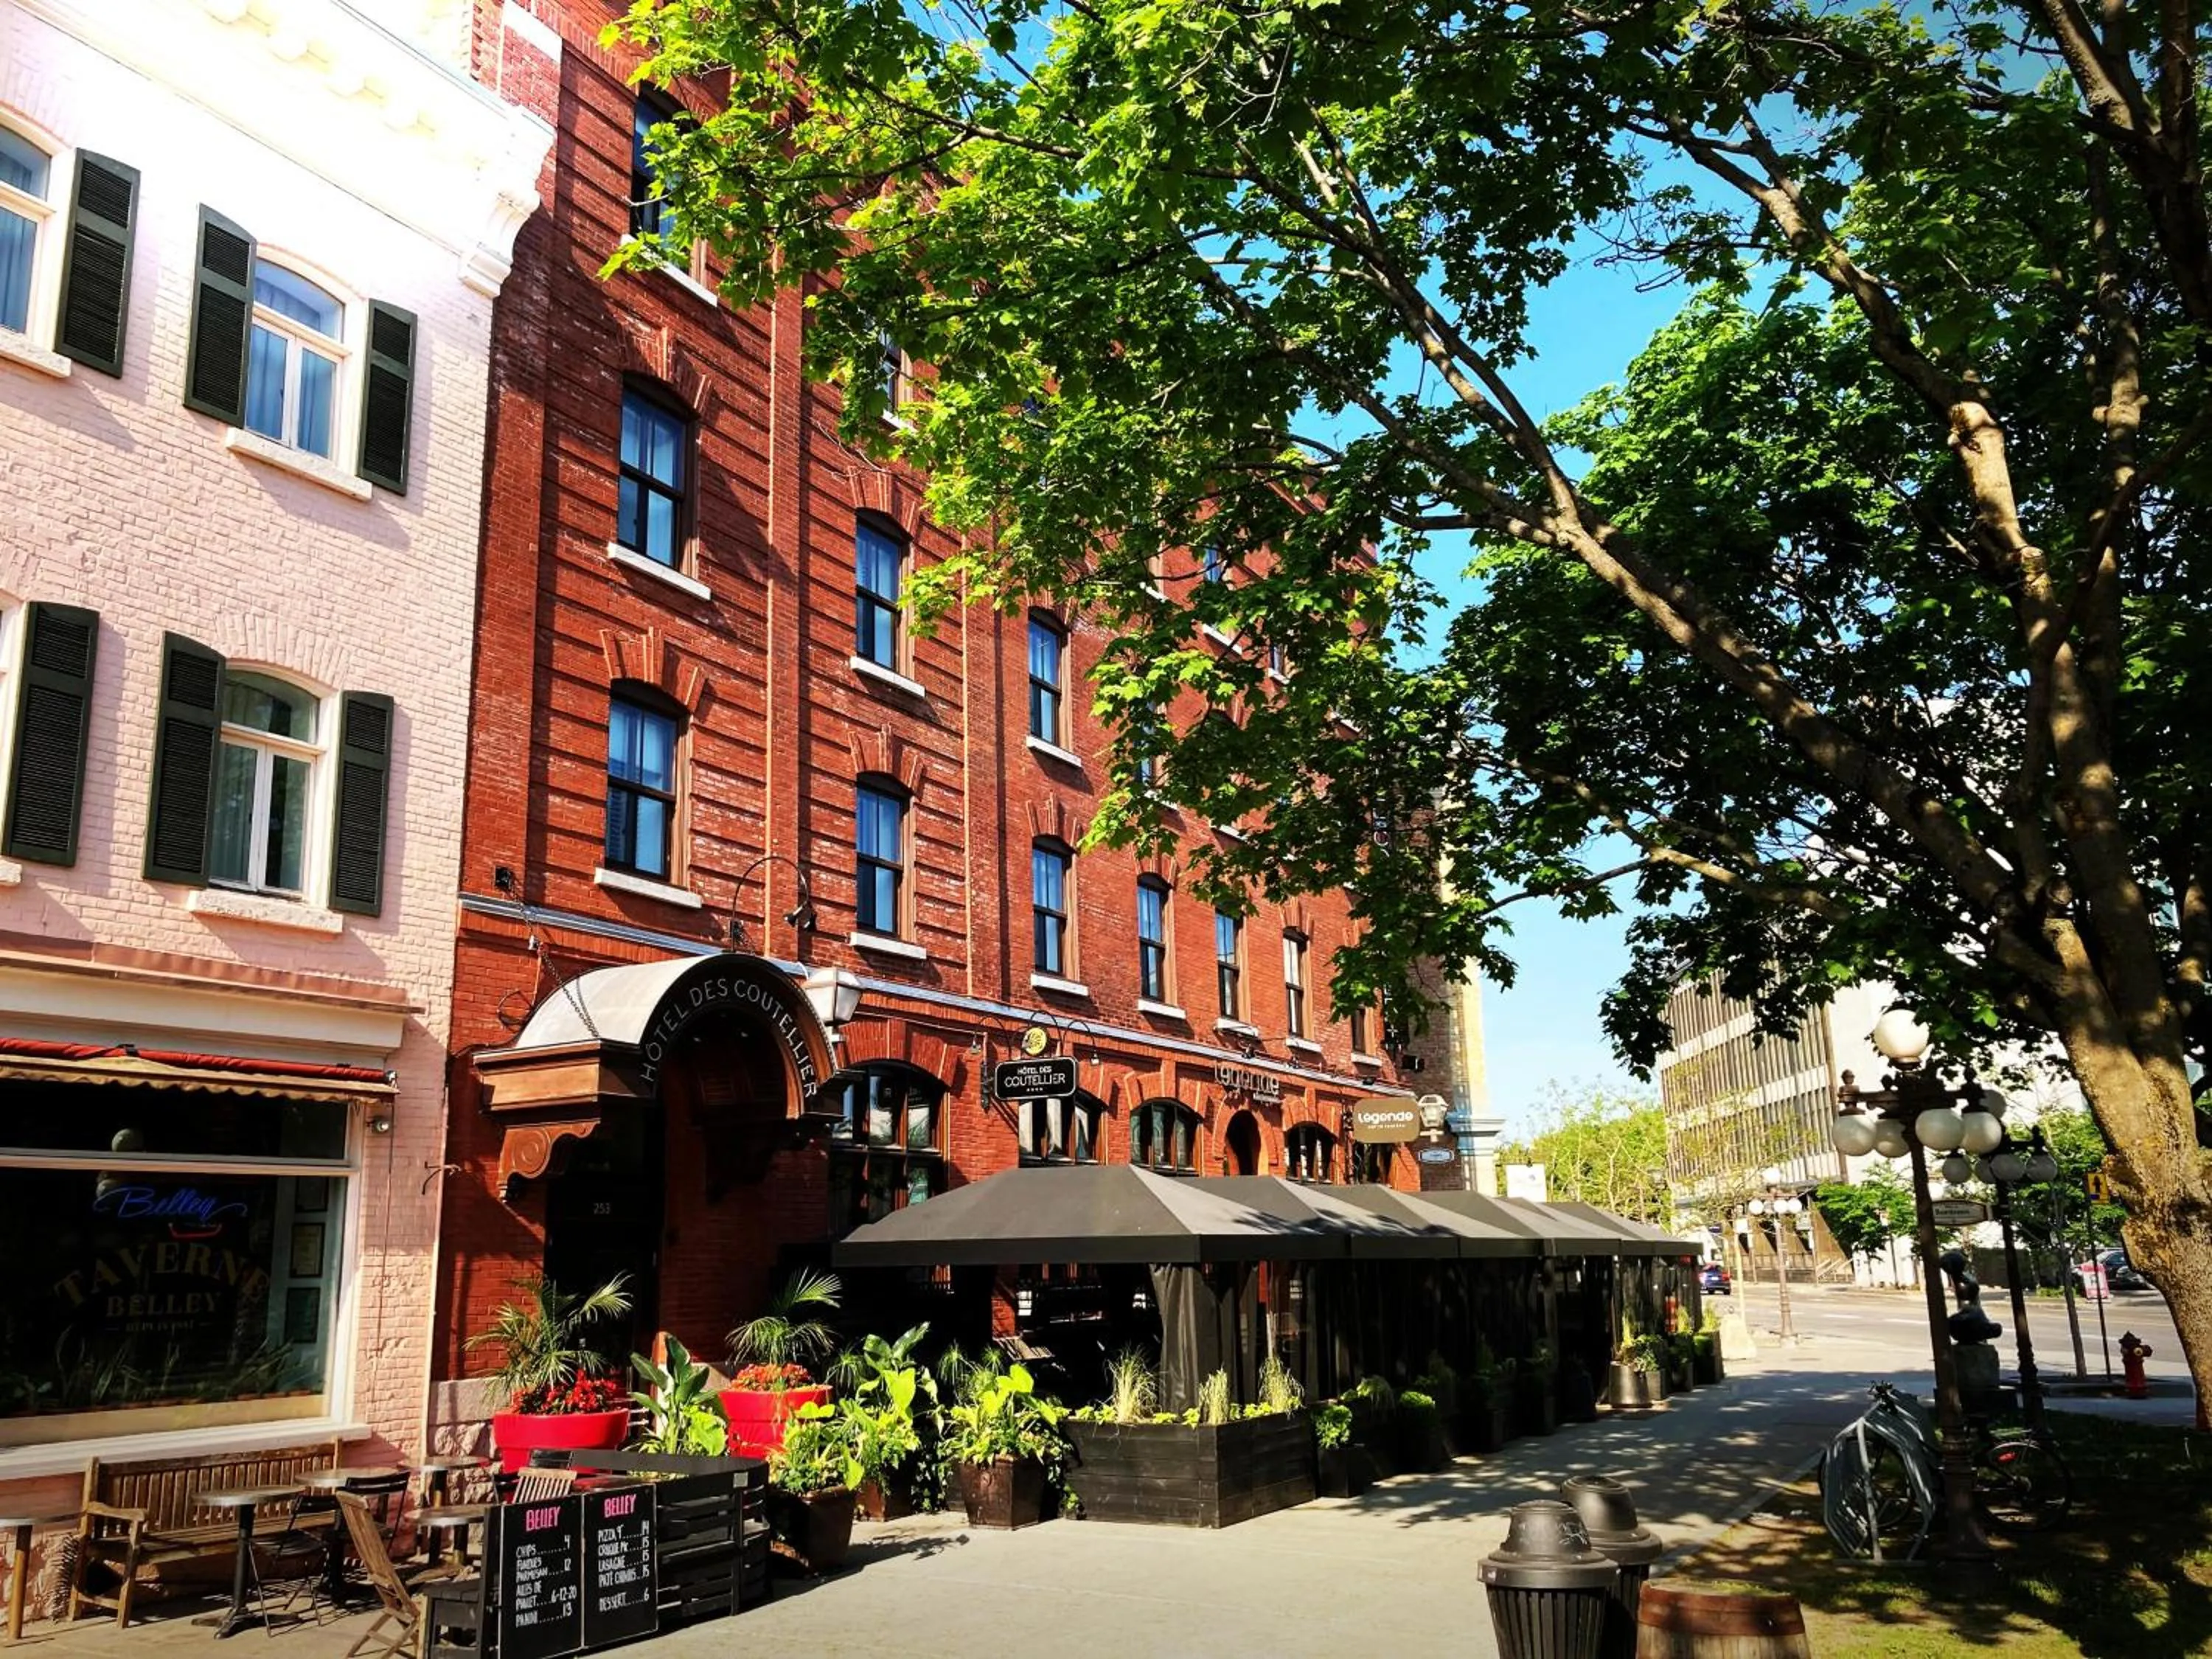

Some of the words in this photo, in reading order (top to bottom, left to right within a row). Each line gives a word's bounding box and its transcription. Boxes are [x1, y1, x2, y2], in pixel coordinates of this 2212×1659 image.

[640, 1002, 689, 1082] HÔTEL
[689, 978, 728, 1007] DES
[734, 979, 818, 1098] COUTELLIER
[1004, 1074, 1065, 1087] COUTELLIER
[1040, 1065, 1052, 1074] DES
[93, 1186, 248, 1222] Belley
[53, 1241, 271, 1307] TAVERNE
[105, 1292, 221, 1318] BELLEY
[526, 1506, 561, 1531] BELLEY
[604, 1494, 636, 1519] BELLEY
[642, 1536, 650, 1548] 15
[642, 1549, 650, 1562] 15
[642, 1564, 650, 1577] 15
[563, 1602, 573, 1617] 13
[599, 1591, 627, 1612] DESSERT
[643, 1587, 650, 1601] 6
